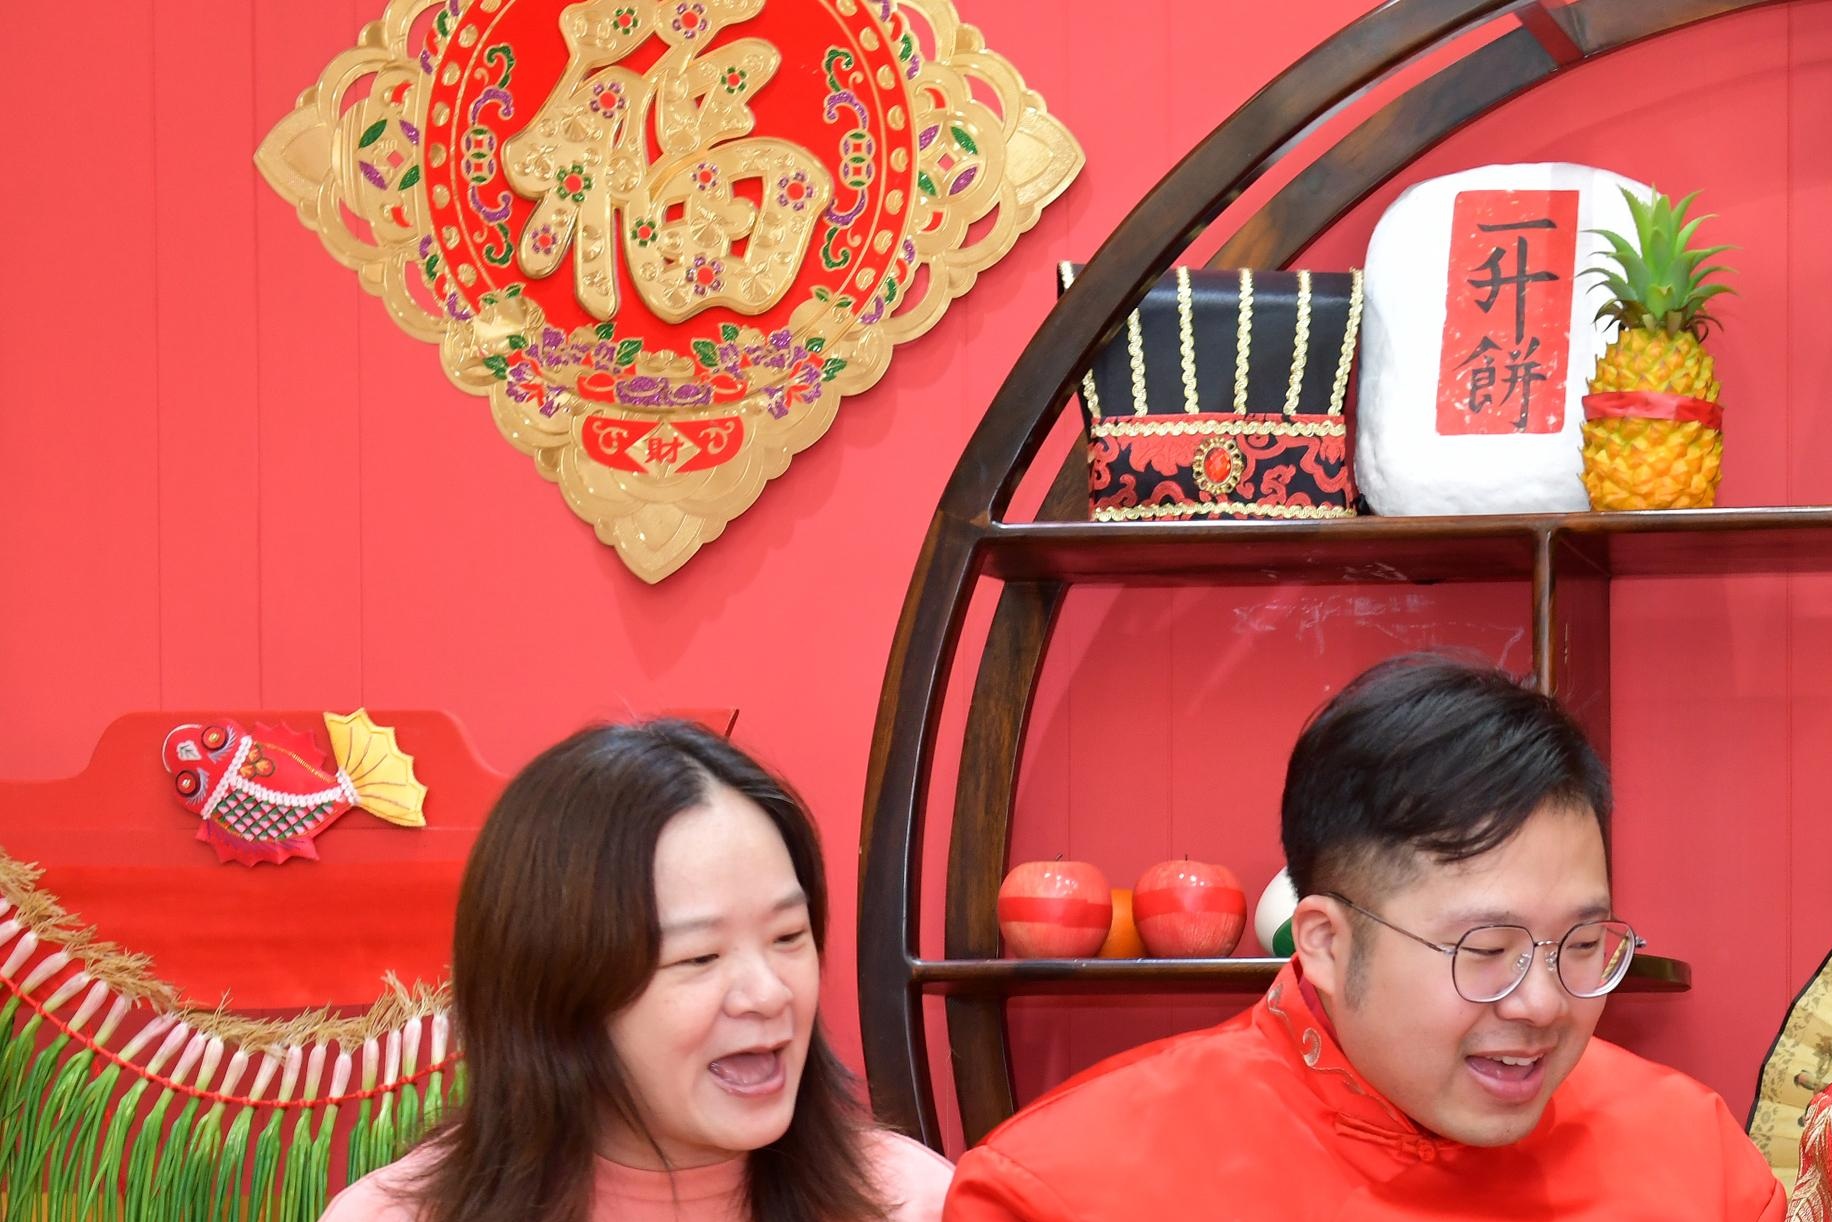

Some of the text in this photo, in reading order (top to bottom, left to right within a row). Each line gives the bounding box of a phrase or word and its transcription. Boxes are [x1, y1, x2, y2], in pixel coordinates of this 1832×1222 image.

[501, 0, 834, 325] 福
[1454, 217, 1561, 434] 一升餅
[644, 435, 686, 465] 財
